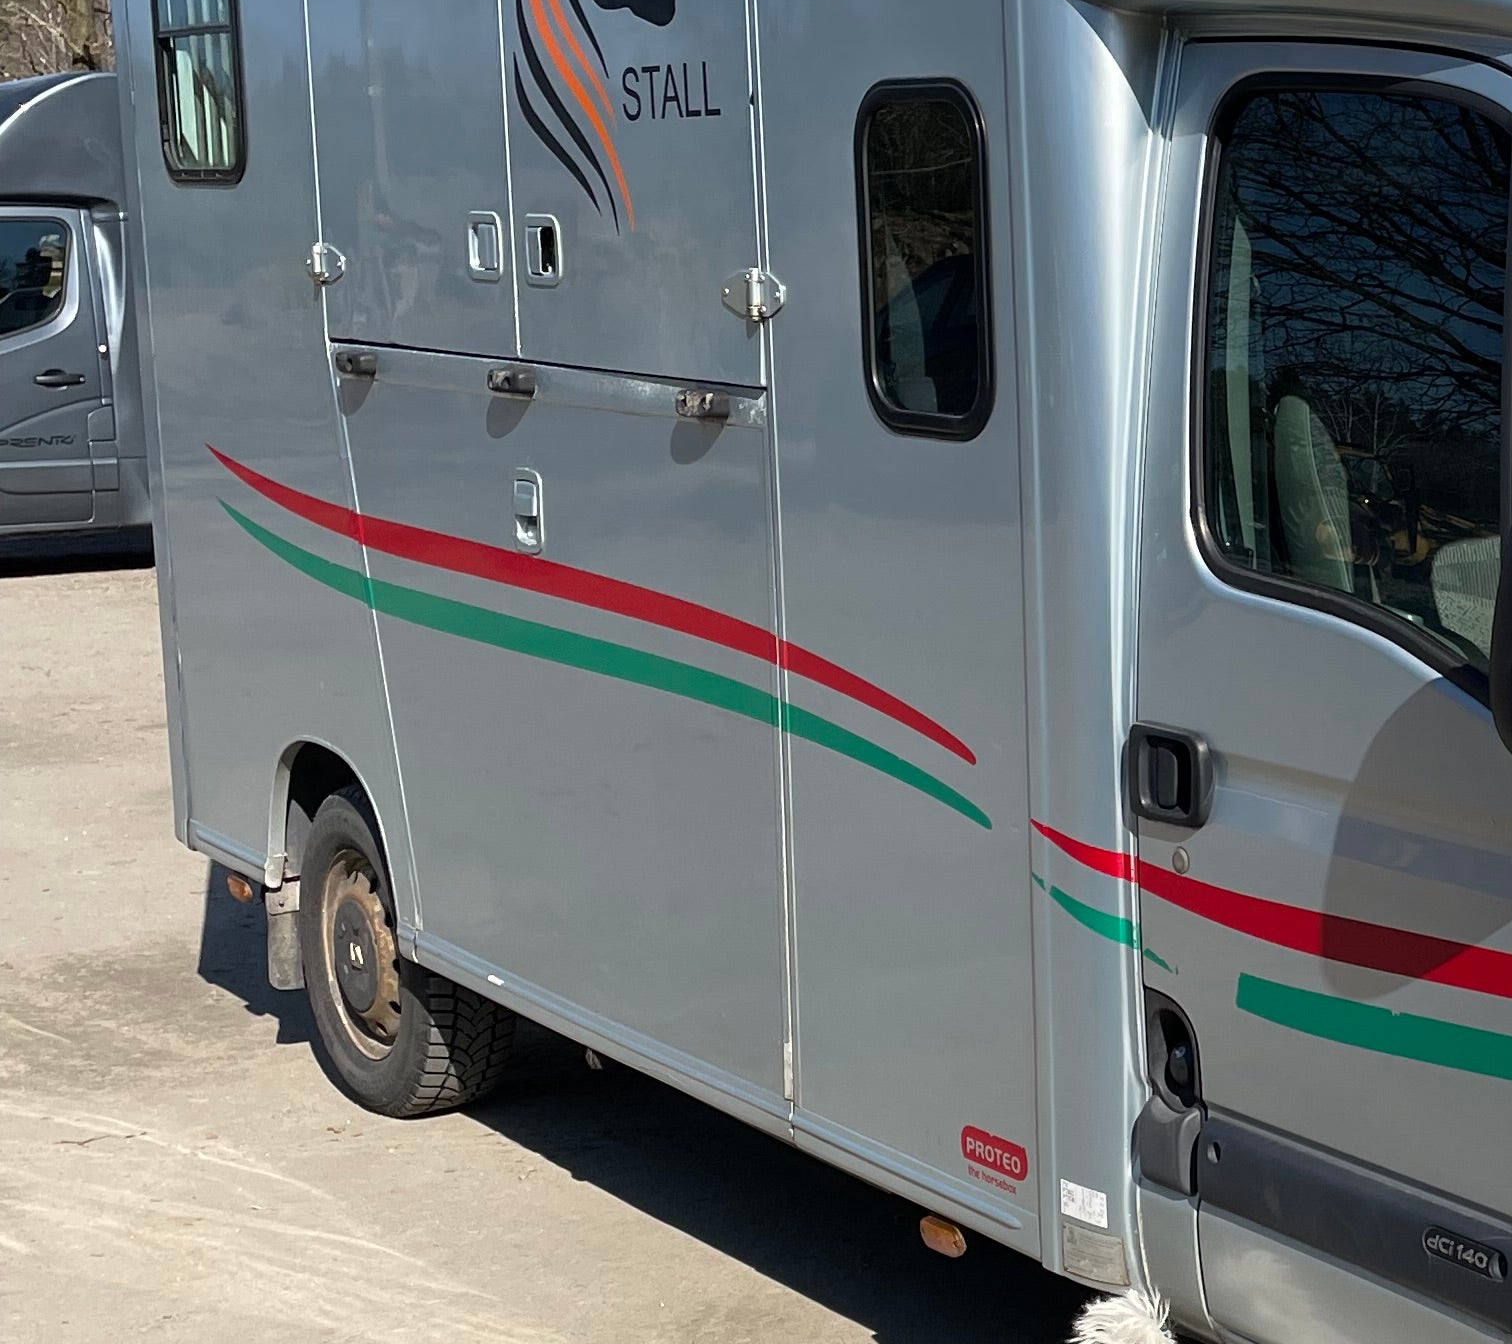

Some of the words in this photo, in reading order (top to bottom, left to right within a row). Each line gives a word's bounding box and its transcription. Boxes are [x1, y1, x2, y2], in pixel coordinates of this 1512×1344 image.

[622, 60, 721, 122] STALL
[965, 1136, 1022, 1175] PROTEO
[967, 1163, 981, 1180] the
[1426, 1234, 1455, 1256] dCi
[1456, 1244, 1489, 1269] 140
